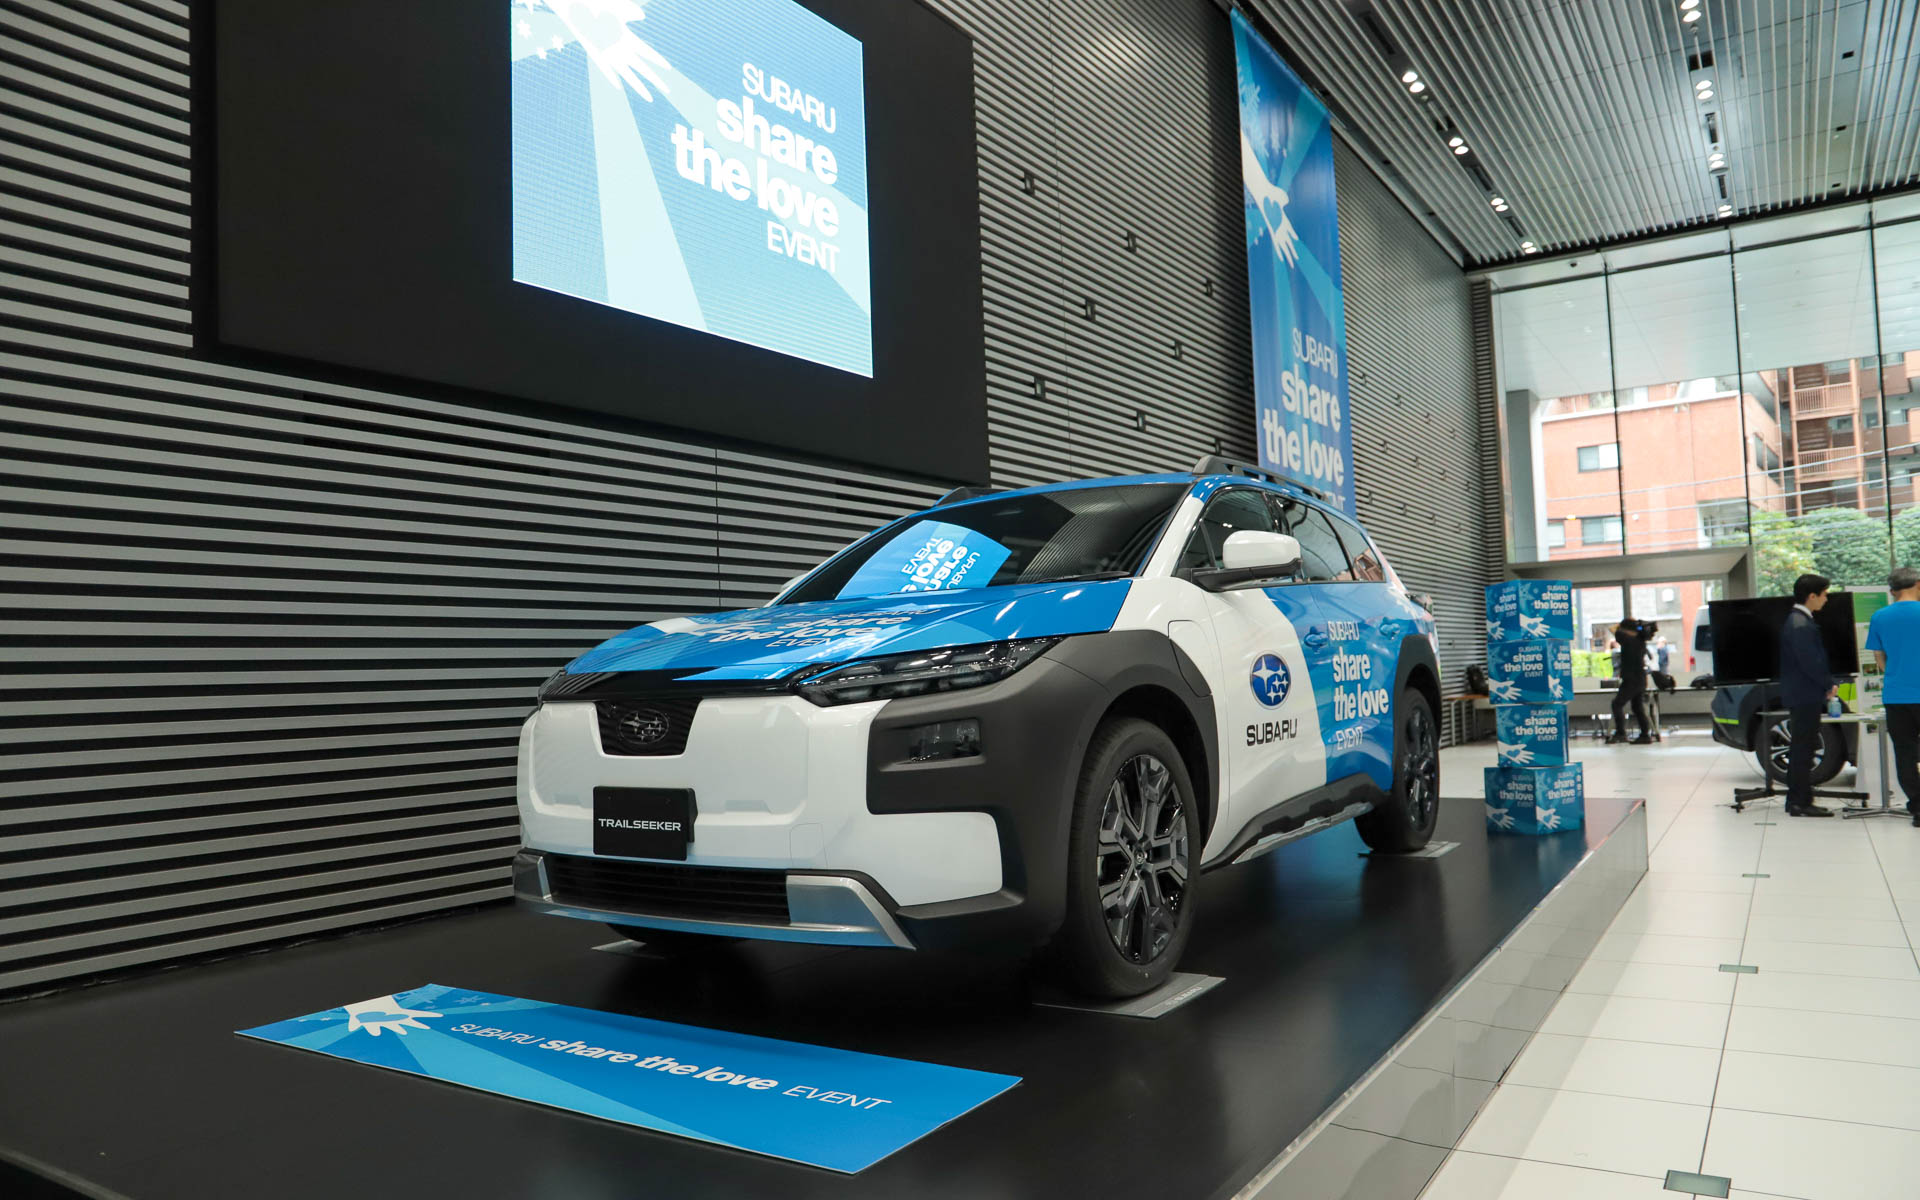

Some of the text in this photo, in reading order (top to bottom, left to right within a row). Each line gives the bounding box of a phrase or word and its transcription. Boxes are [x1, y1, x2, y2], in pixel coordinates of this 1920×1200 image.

[742, 62, 836, 134] SUBARU
[716, 95, 838, 185] share
[670, 123, 840, 238] the love
[767, 220, 840, 274] EVENT
[1293, 327, 1338, 379] SUBARU
[1281, 363, 1341, 433] share
[1262, 408, 1344, 487] the love
[1533, 600, 1569, 609] the love
[1541, 591, 1569, 600] share
[776, 615, 911, 630] share
[1328, 620, 1360, 641] SUBARU
[708, 627, 882, 643] the love
[1333, 646, 1371, 683] share
[1512, 653, 1543, 662] share
[1504, 662, 1543, 672] the love
[1334, 683, 1389, 722] the love
[1525, 716, 1557, 725] share
[1246, 718, 1298, 747] SUBARU
[1336, 726, 1363, 750] EVENT
[1515, 725, 1558, 735] the love
[1507, 781, 1533, 791] share
[1554, 779, 1575, 789] share
[1560, 788, 1576, 798] love
[1499, 790, 1534, 801] the love
[598, 818, 682, 831] TRAILSEEKER
[451, 1023, 893, 1110] SUBARU share the love EVENT
